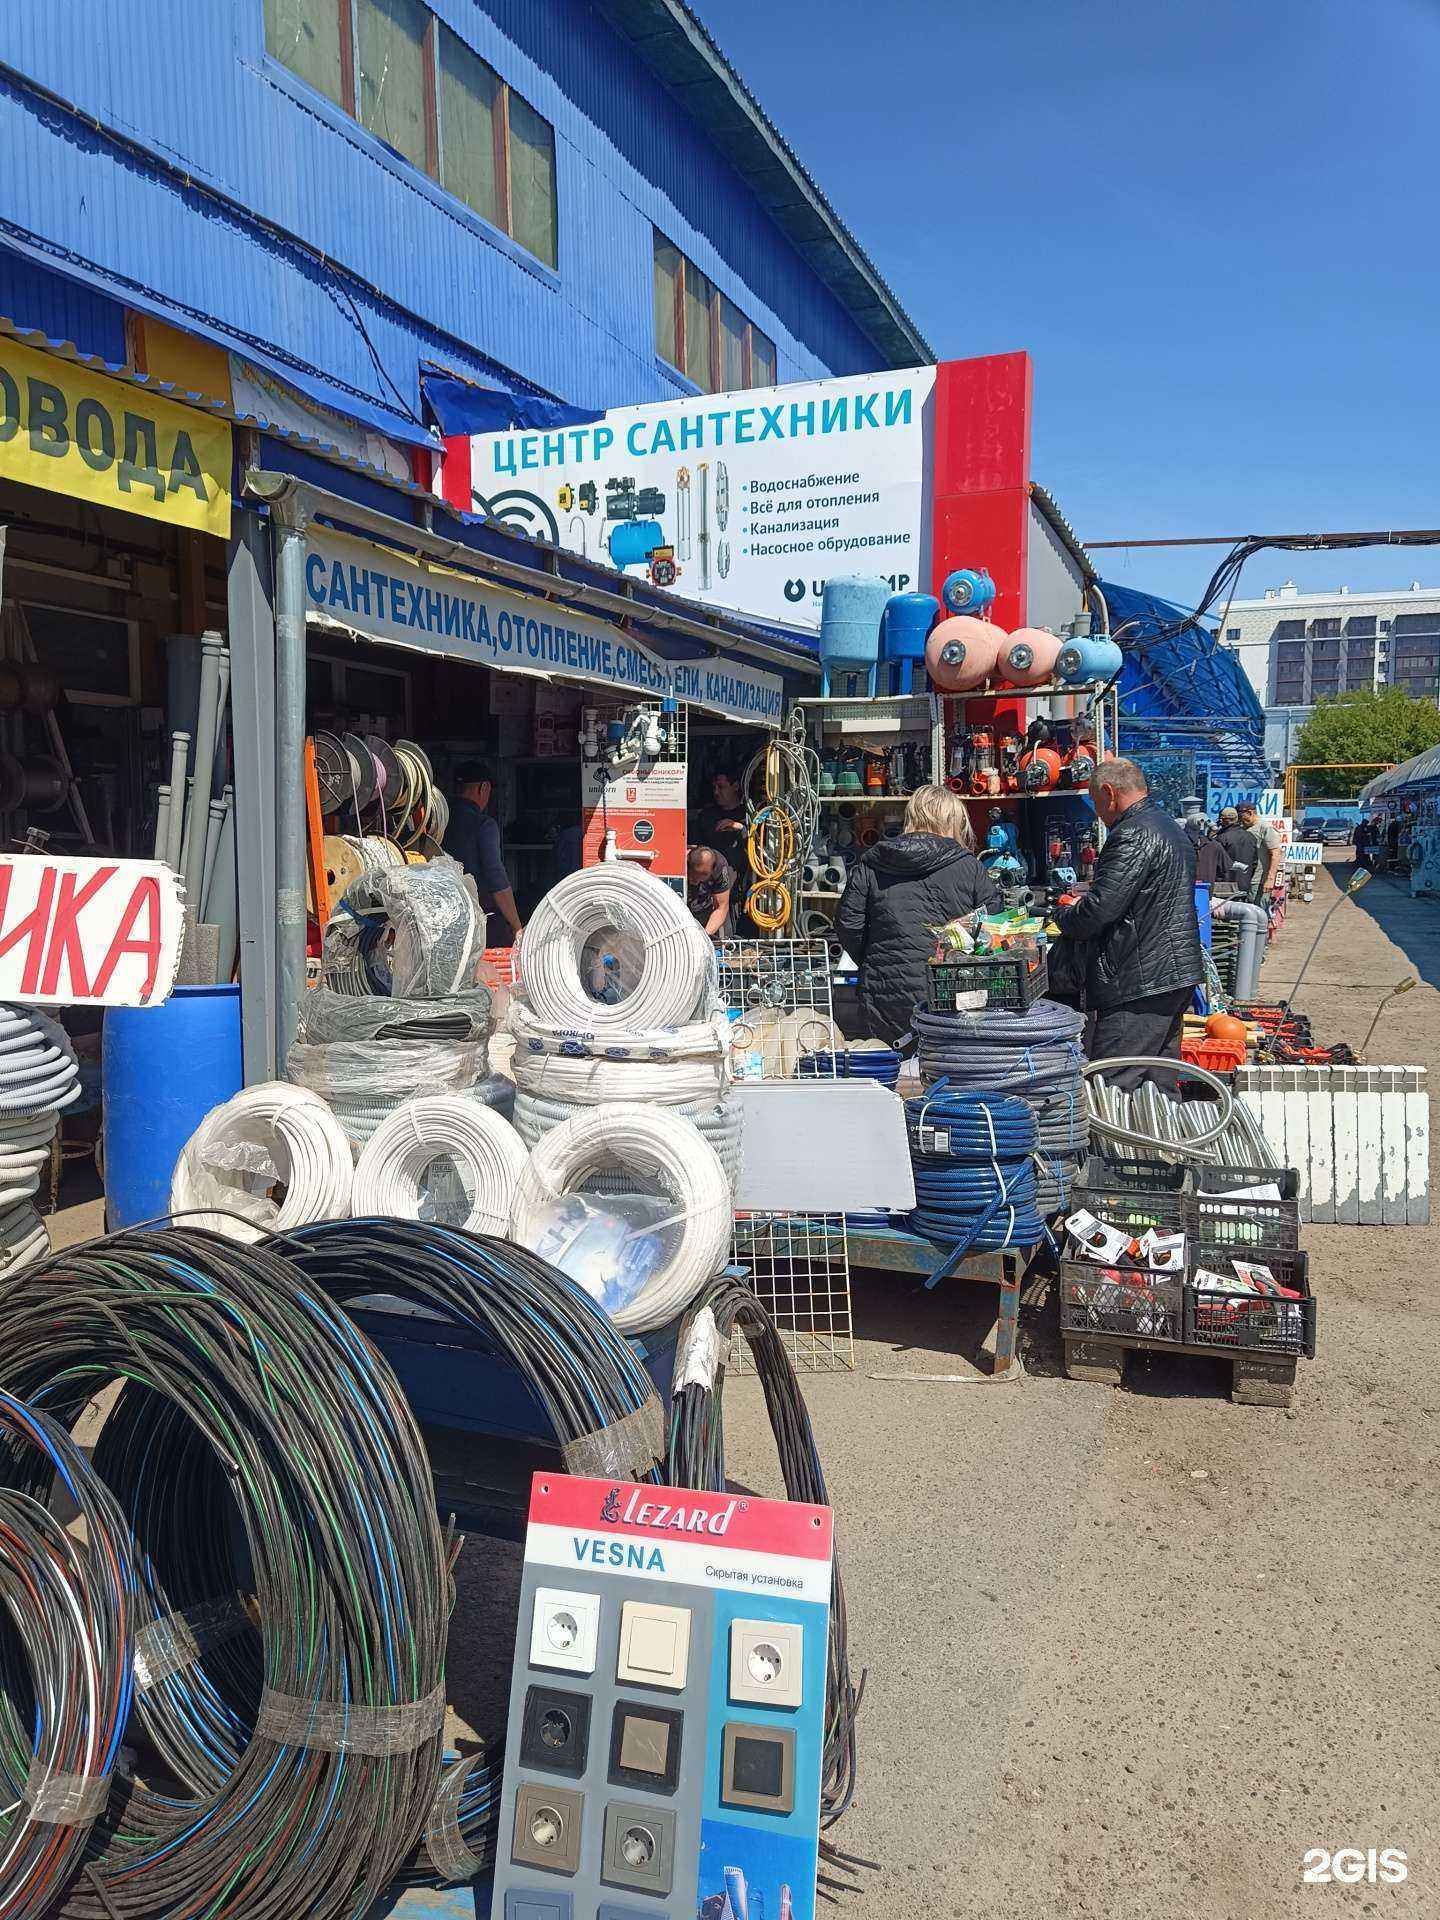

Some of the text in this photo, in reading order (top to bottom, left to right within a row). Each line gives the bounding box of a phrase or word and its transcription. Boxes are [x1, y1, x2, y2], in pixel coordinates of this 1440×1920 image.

[494, 389, 912, 477] ЦЕНТР САНТЕХНИКИ
[750, 472, 860, 494] Водоснабжение
[750, 492, 880, 515] Всё для отопления
[750, 518, 839, 535] Канализация
[751, 533, 911, 556] Насосное обрудование
[706, 672, 782, 717] КАНАЛИЗАЦИЯ
[573, 1537, 667, 1572] VESNA
[705, 1565, 804, 1589] Скрытая установка
